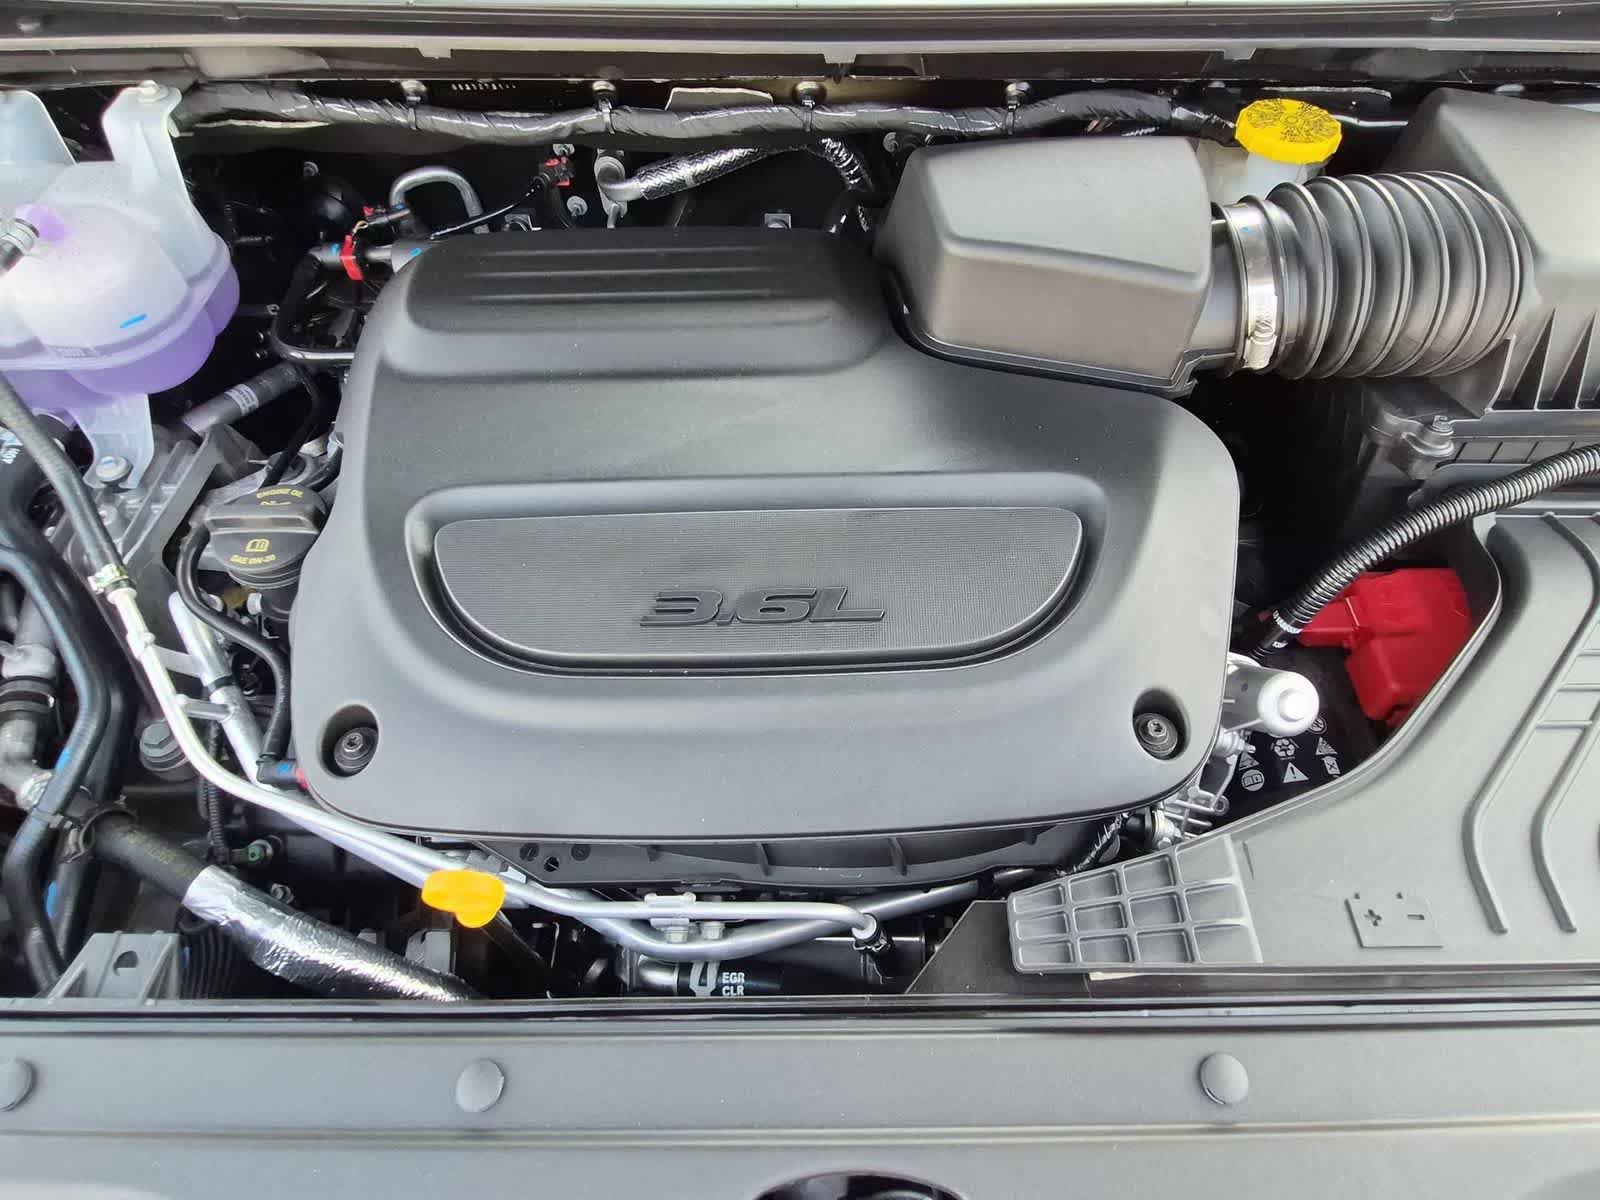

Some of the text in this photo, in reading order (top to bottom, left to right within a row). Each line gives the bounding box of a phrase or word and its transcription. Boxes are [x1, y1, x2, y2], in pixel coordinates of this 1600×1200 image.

[639, 586, 886, 626] 3.6L
[721, 971, 745, 984] EGR
[721, 985, 745, 996] CLR
